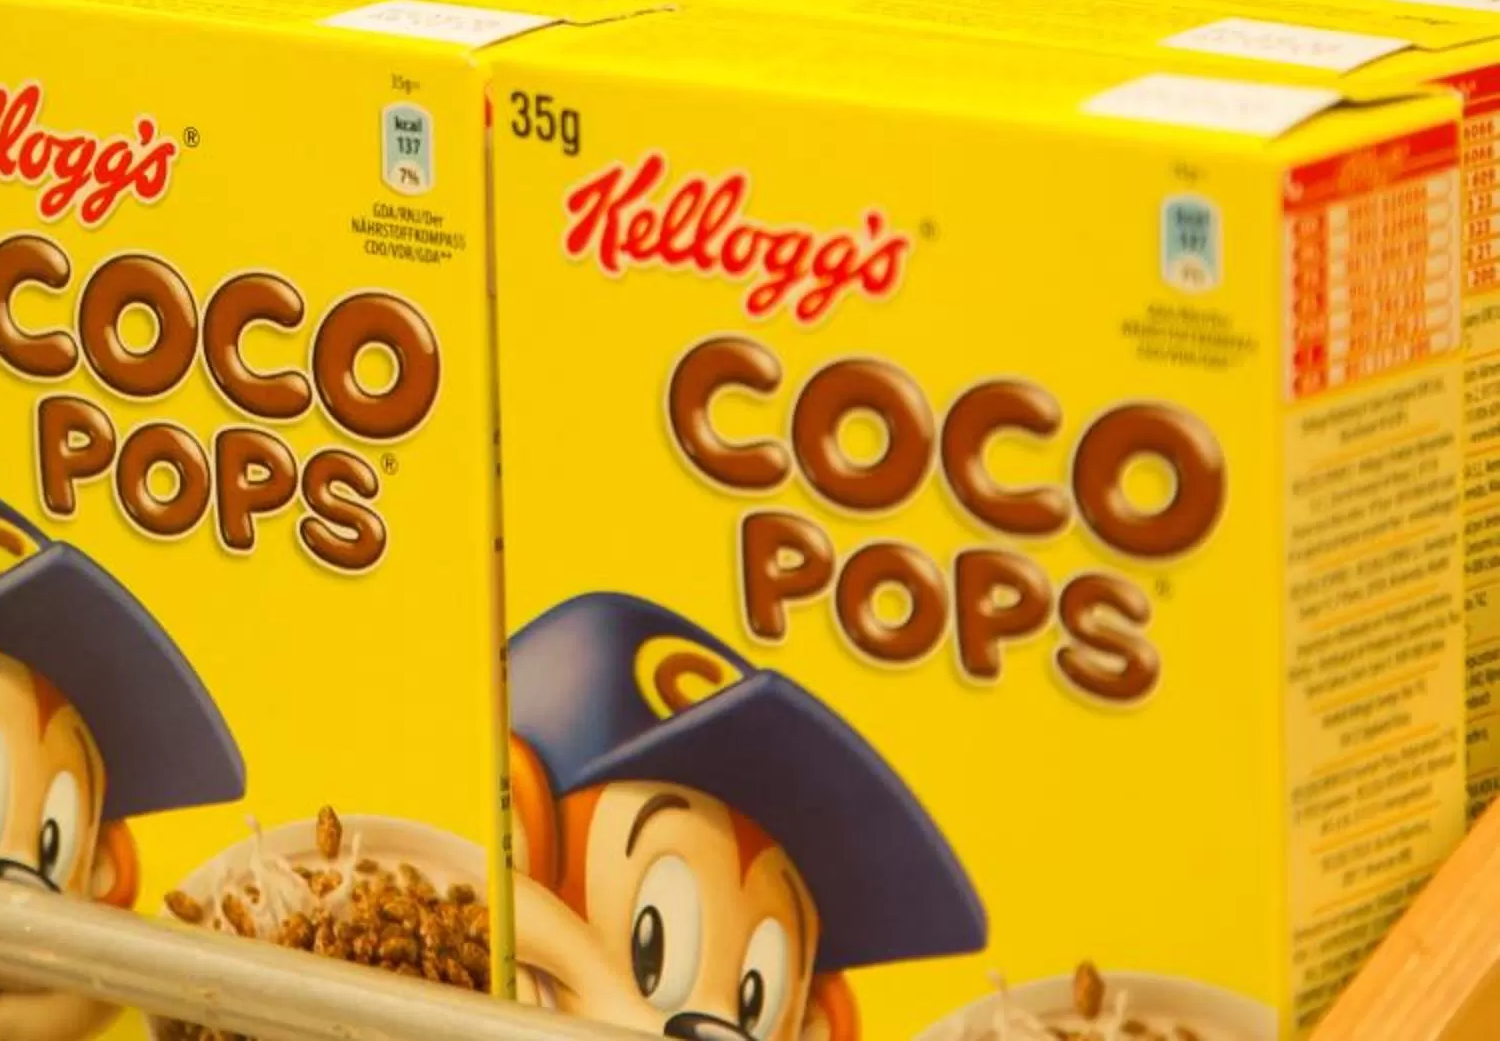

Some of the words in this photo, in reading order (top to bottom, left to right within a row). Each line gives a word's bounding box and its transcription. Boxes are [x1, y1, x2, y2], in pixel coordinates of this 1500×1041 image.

[394, 115, 422, 133] kcal
[397, 136, 421, 155] 137
[510, 91, 582, 156] 35g
[566, 154, 908, 323] Kellogg's
[37, 395, 388, 570] POPS
[667, 334, 1228, 562] COCO
[740, 510, 1160, 705] POPS
